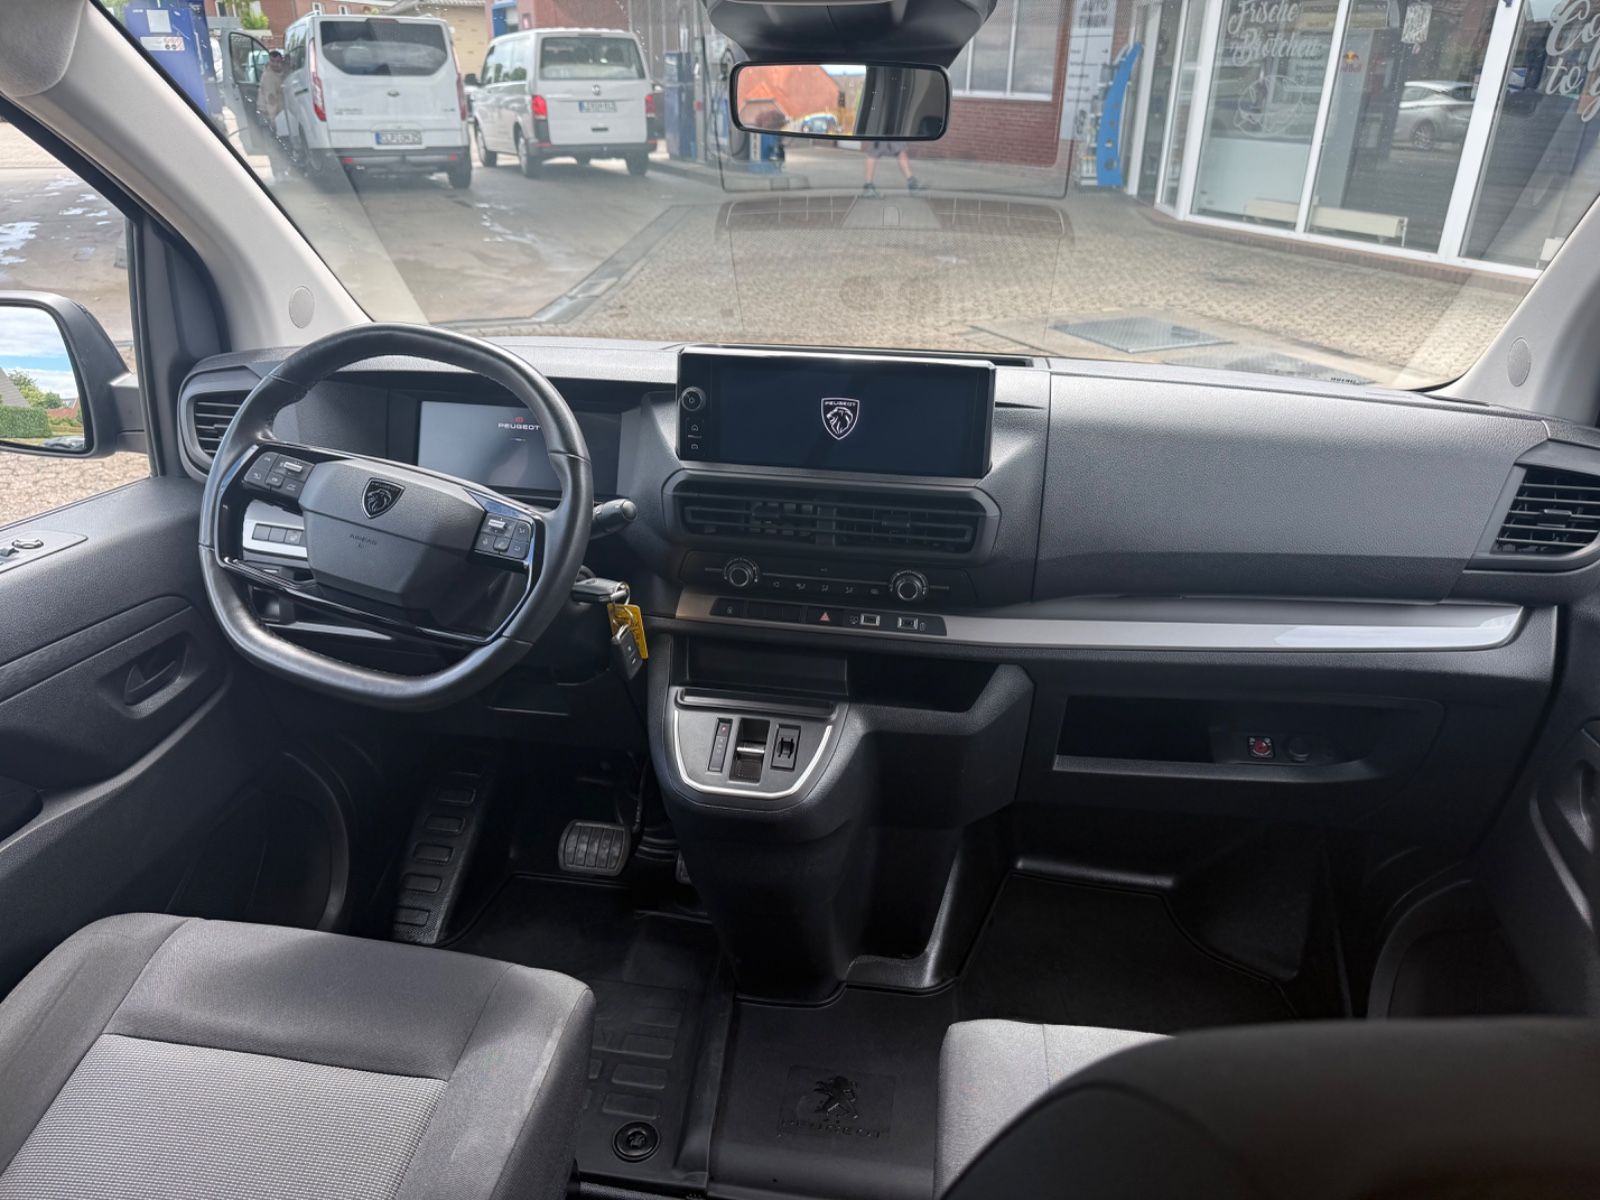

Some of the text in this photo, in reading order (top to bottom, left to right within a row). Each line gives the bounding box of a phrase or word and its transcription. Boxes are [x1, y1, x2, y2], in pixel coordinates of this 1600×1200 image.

[1228, 0, 1302, 34] Frische
[1230, 28, 1320, 67] Brötchen
[1545, 57, 1584, 95] to
[498, 422, 540, 430] PEUGEOT
